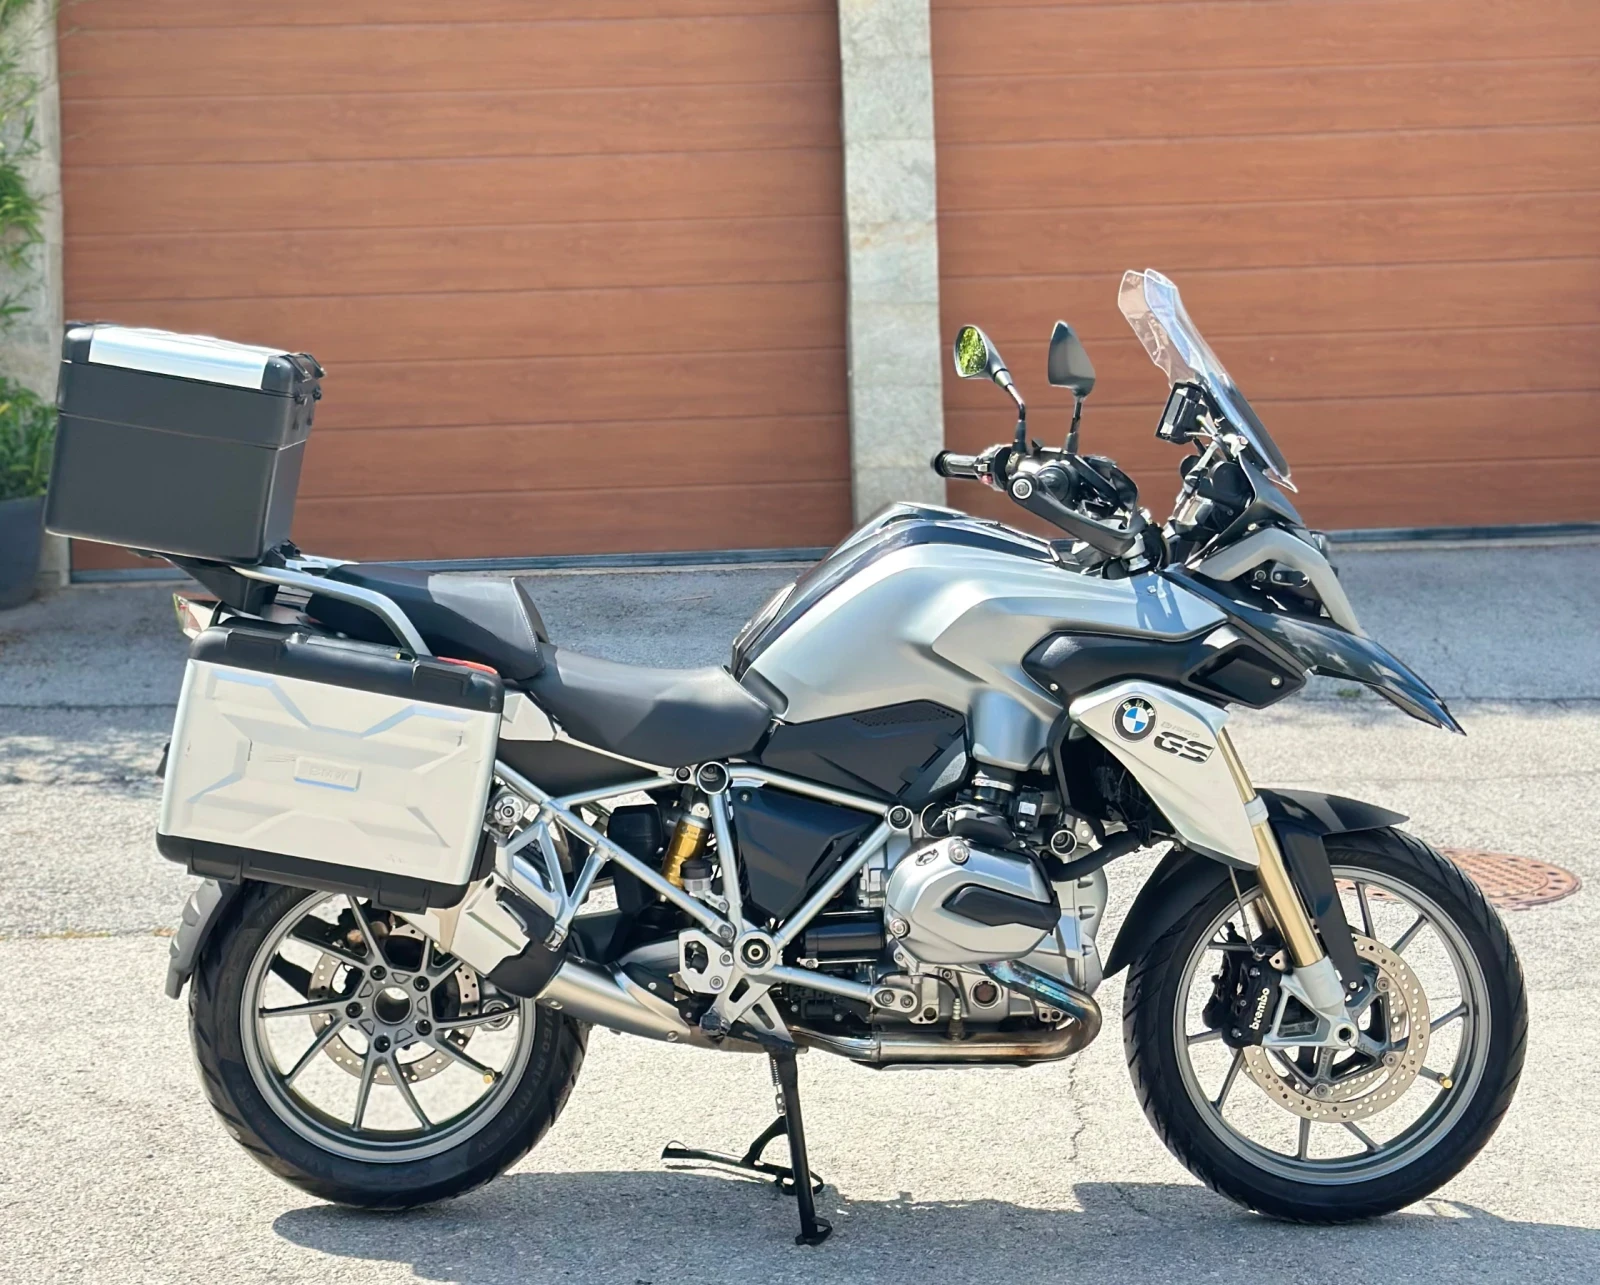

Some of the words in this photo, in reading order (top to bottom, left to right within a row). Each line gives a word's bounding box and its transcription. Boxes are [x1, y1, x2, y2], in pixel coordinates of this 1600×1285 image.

[1122, 700, 1155, 717] BMW
[1154, 731, 1215, 763] GS
[1249, 987, 1270, 1031] brembo
